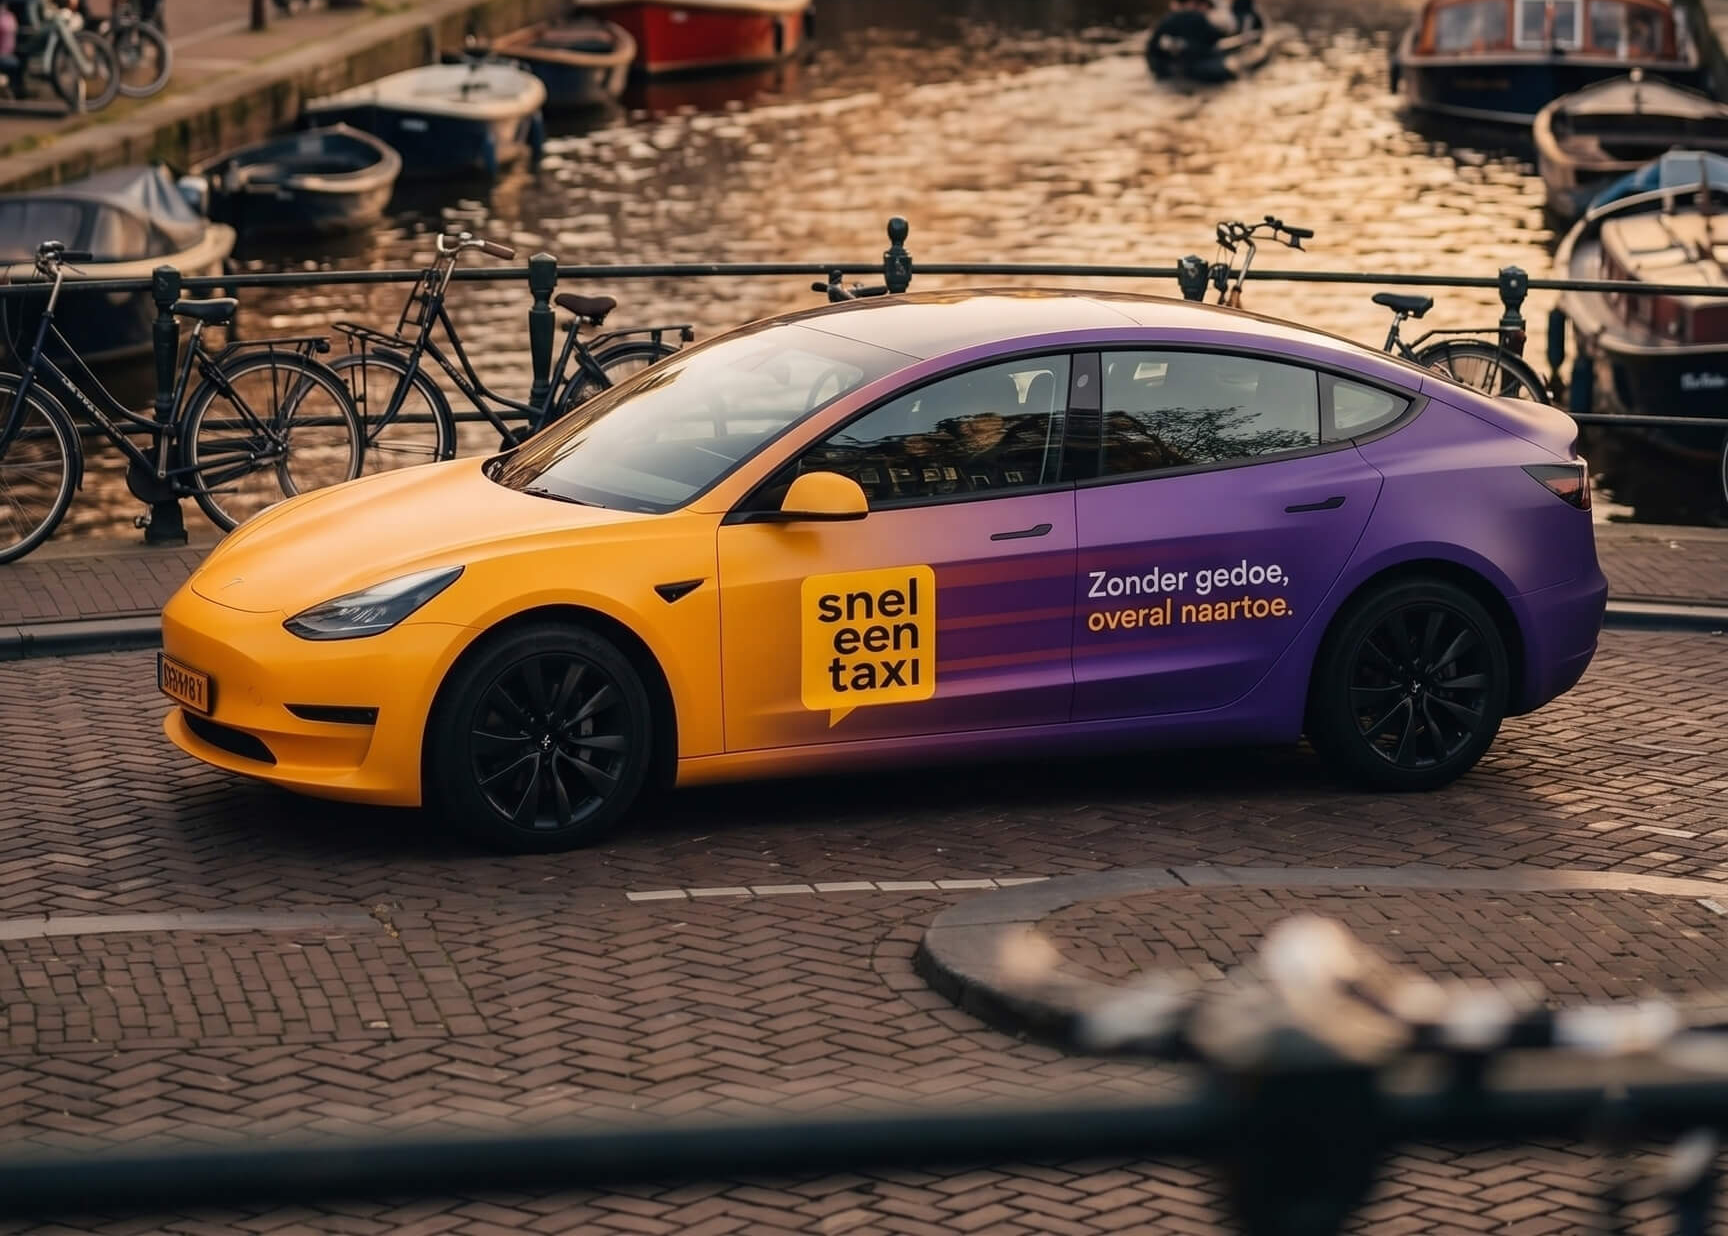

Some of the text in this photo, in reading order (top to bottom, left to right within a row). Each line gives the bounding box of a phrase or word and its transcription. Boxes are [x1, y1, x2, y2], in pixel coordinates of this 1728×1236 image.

[1087, 558, 1290, 599] Zonder gedoe,
[817, 576, 919, 623] snel
[1087, 595, 1294, 632] overal naartoe.
[833, 622, 920, 655] een
